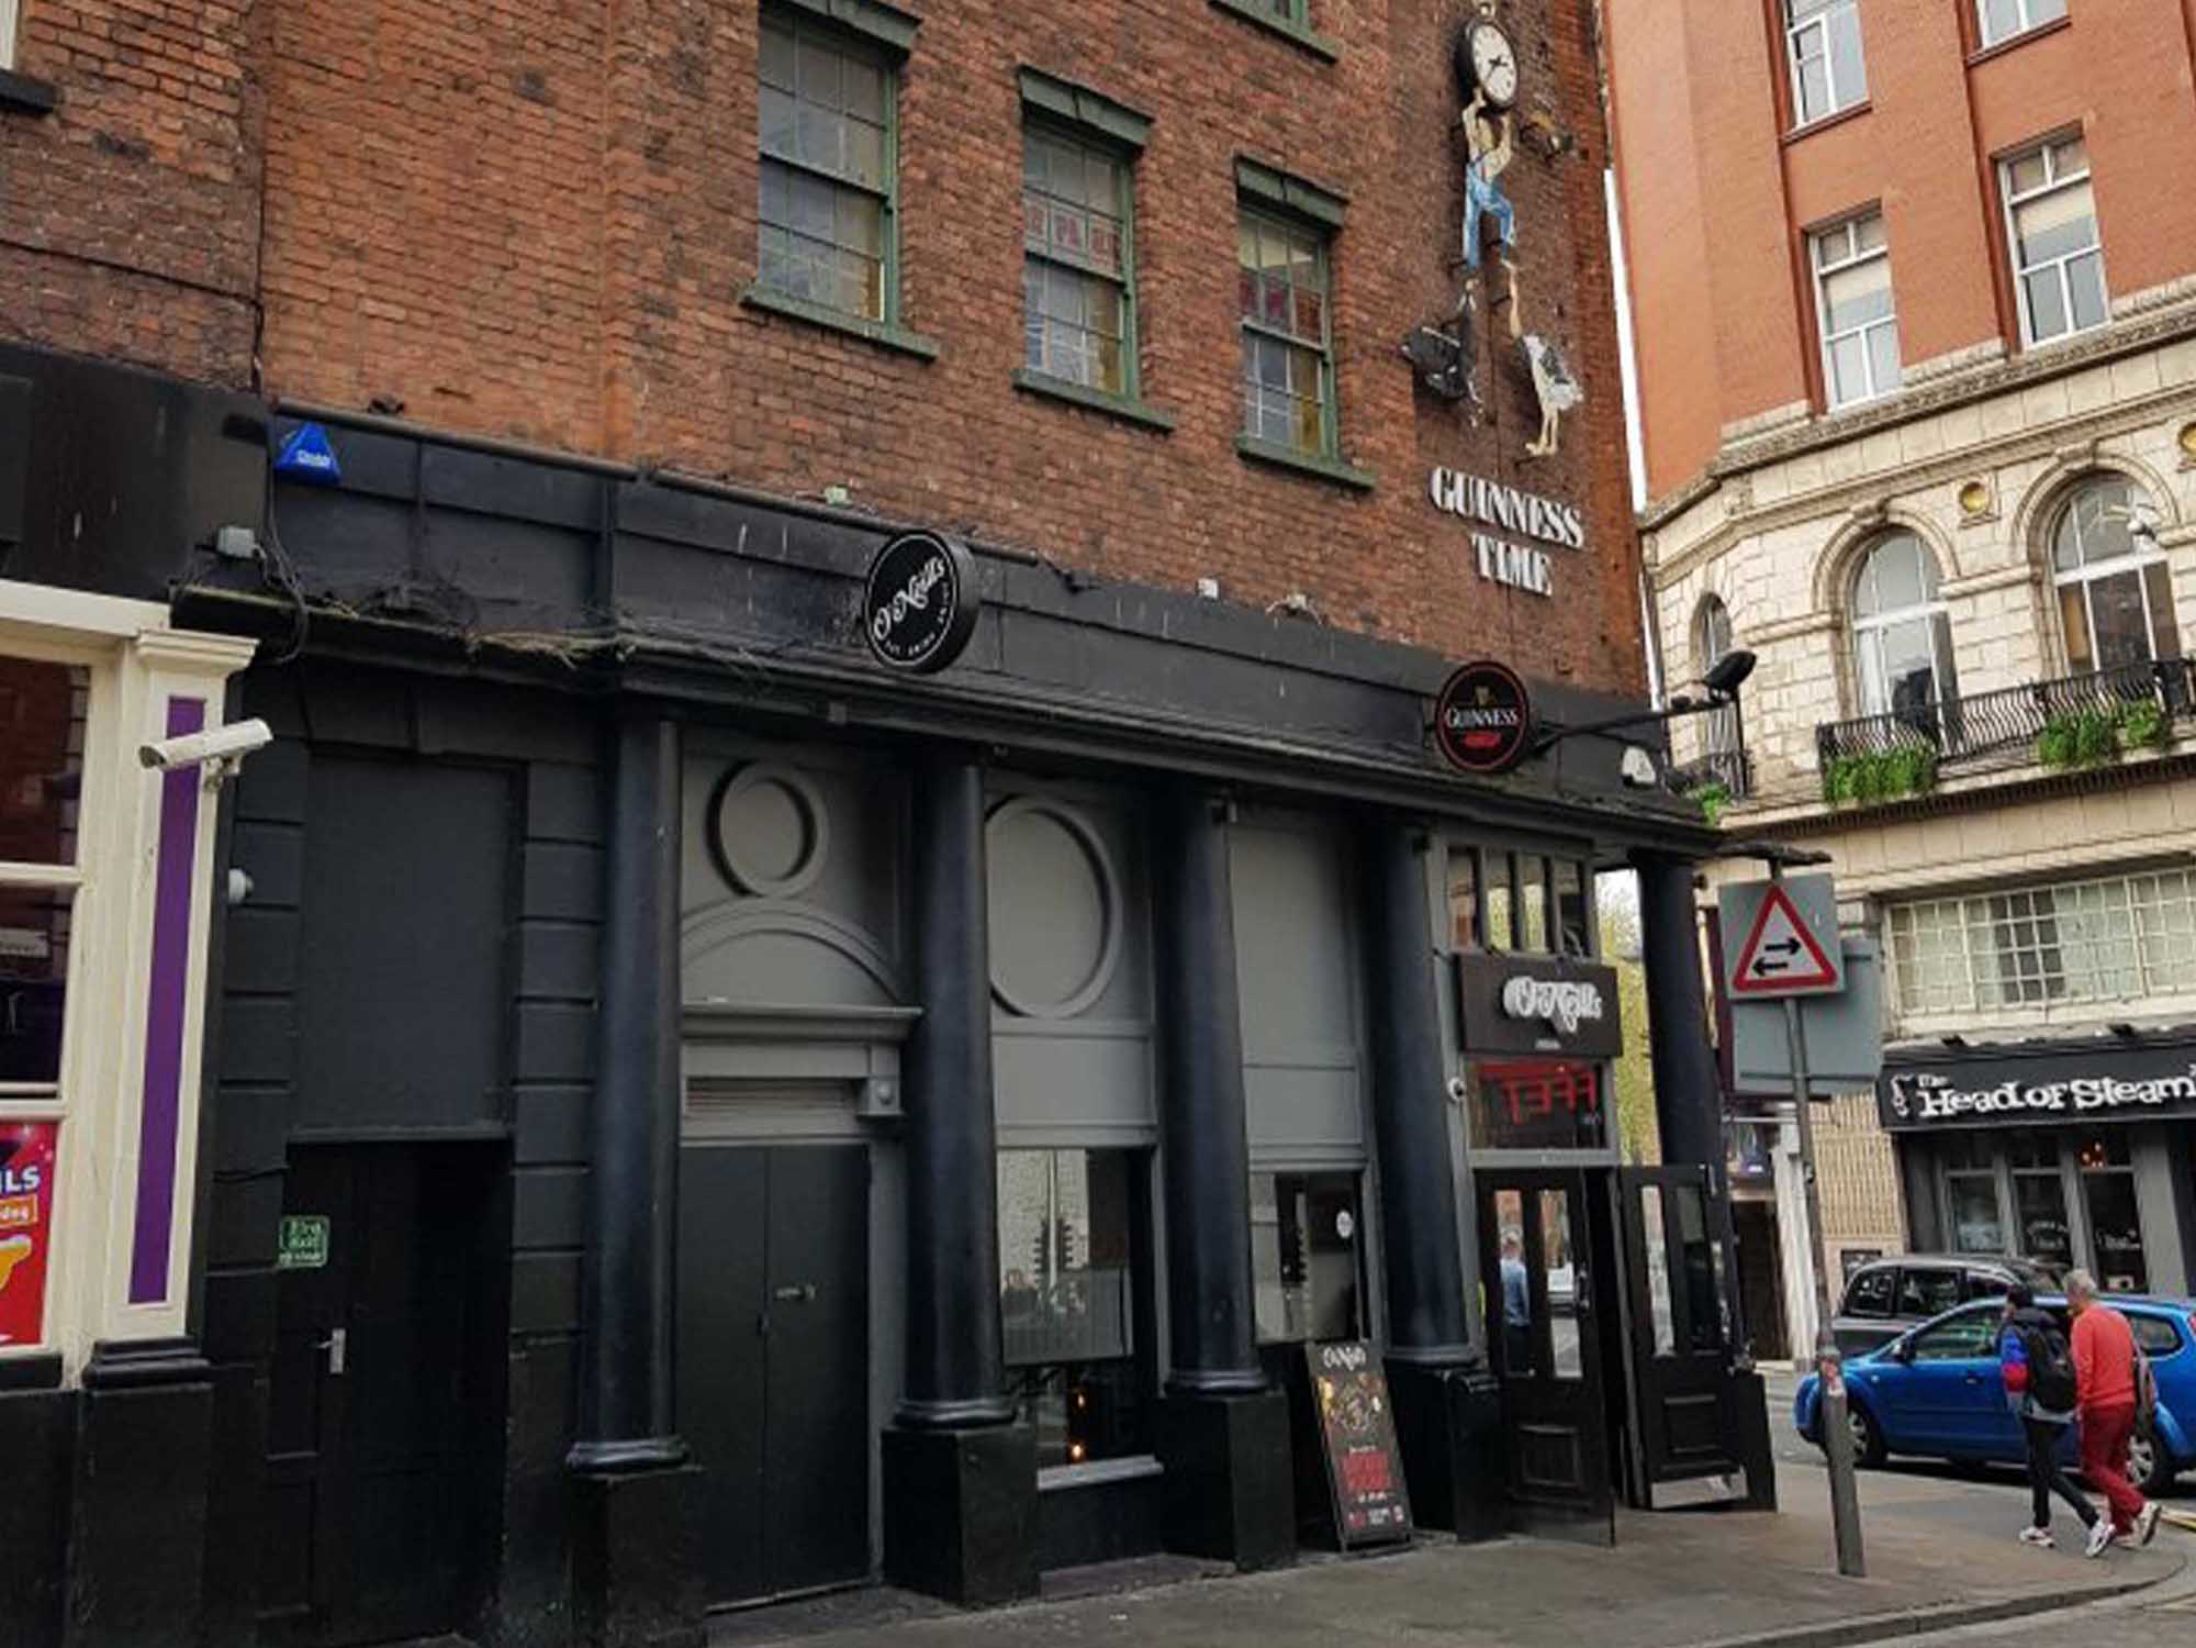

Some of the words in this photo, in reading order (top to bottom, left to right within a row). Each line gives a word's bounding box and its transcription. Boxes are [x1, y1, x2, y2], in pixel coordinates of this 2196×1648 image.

[1430, 466, 1584, 549] GUINNESS
[1470, 532, 1553, 597] TIME
[1444, 707, 1518, 729] GUINNESS
[1916, 1081, 2025, 1118] Head
[2070, 1075, 2196, 1110] Steam
